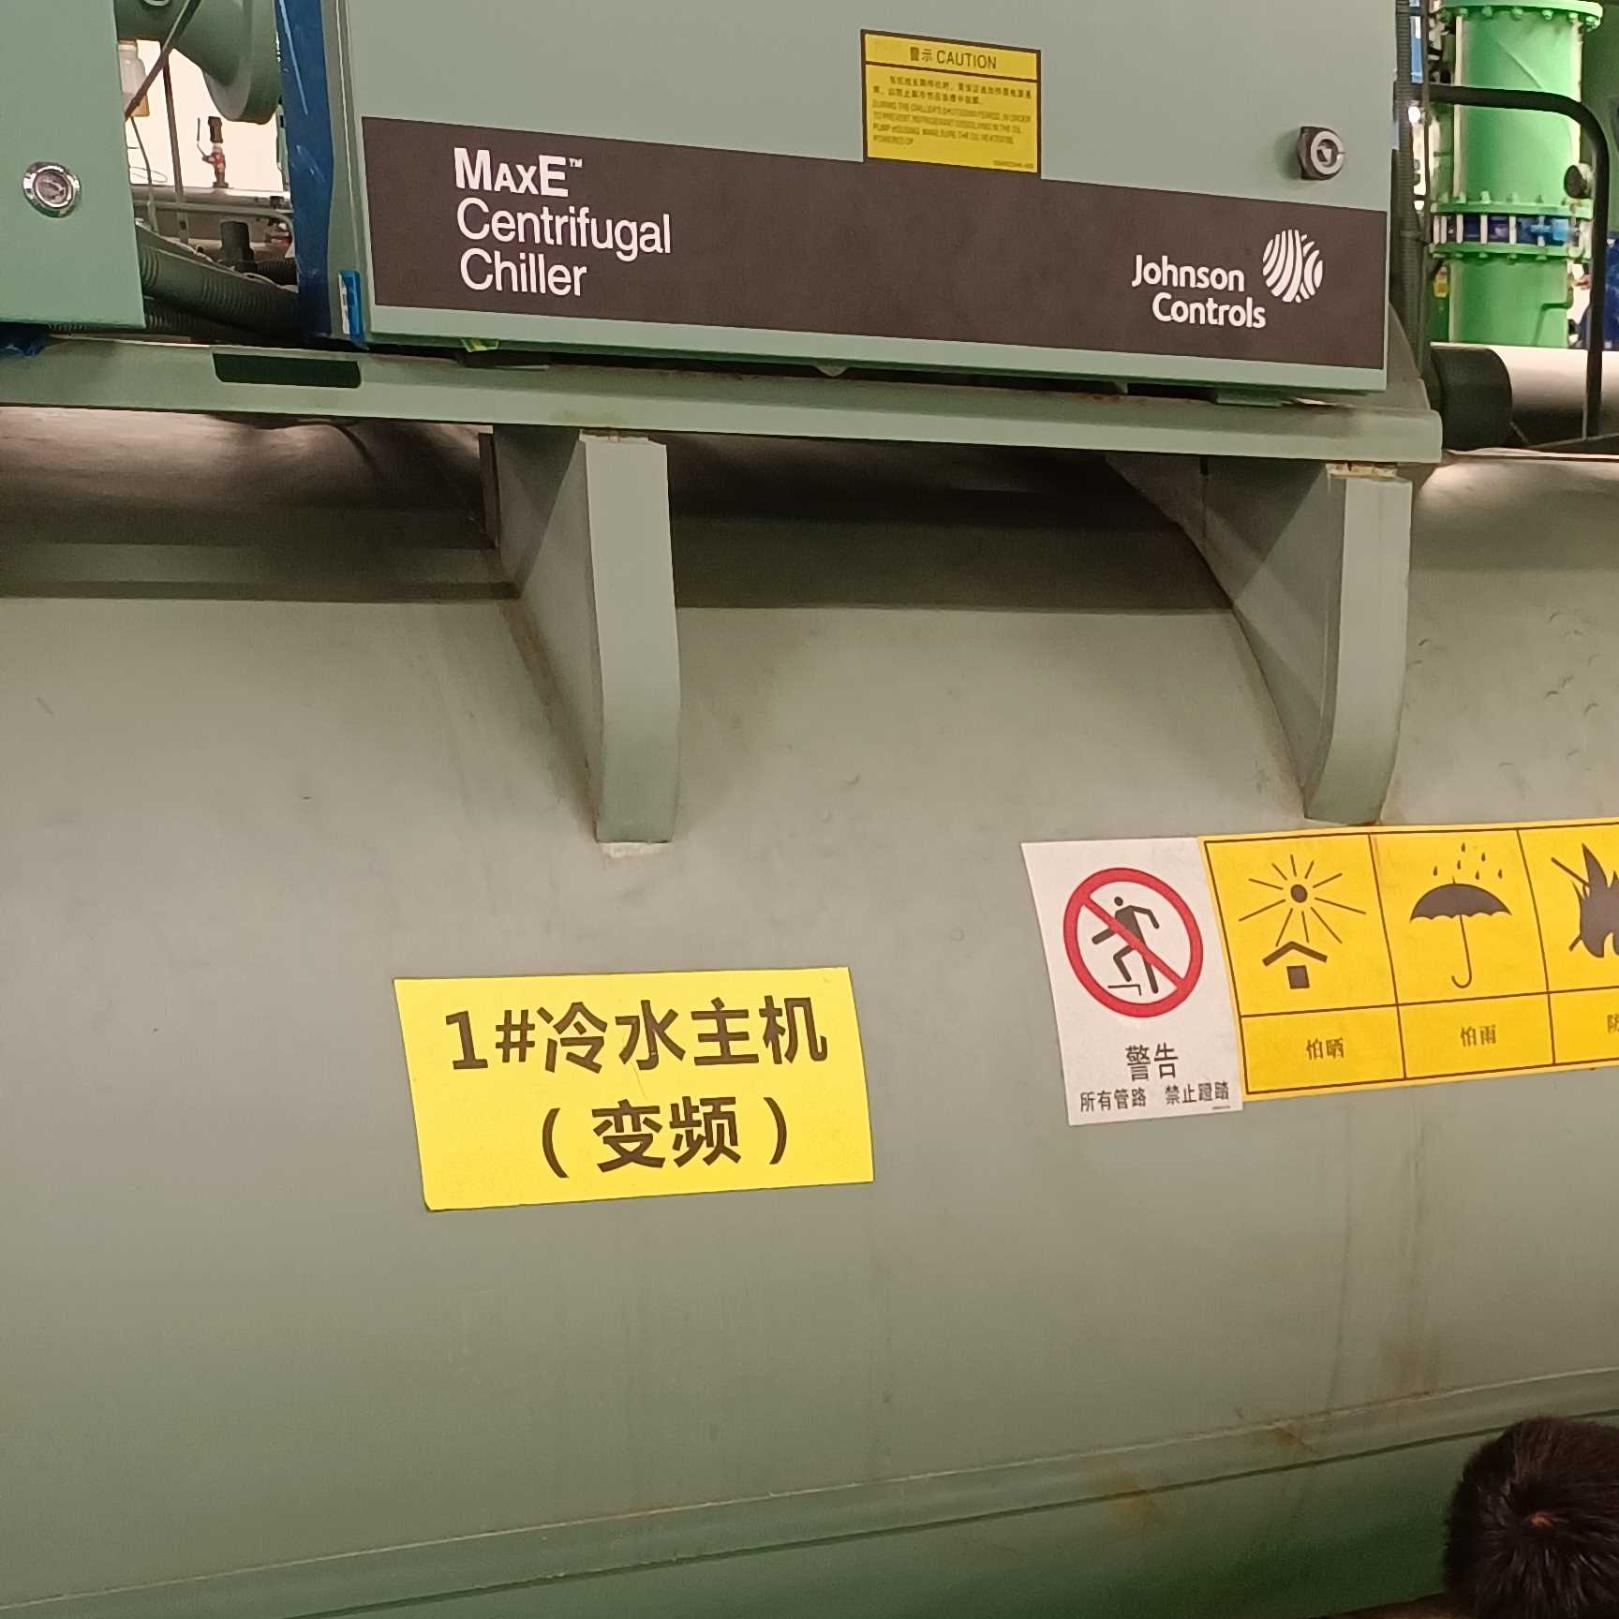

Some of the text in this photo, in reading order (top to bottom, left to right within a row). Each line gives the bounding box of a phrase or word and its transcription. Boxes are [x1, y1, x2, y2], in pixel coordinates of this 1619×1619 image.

[936, 49, 997, 70] CAUTION
[456, 197, 672, 262] Centrifugal
[460, 247, 587, 297] Chiller
[1131, 254, 1245, 292] Johnson
[1152, 292, 1267, 329] Controls
[444, 993, 829, 1074] 1#冷水主机
[1306, 1037, 1346, 1061] 怕晒
[1460, 1024, 1498, 1047] 怕雨
[1125, 1042, 1179, 1082] 警告
[1080, 1086, 1147, 1113] 所有管路
